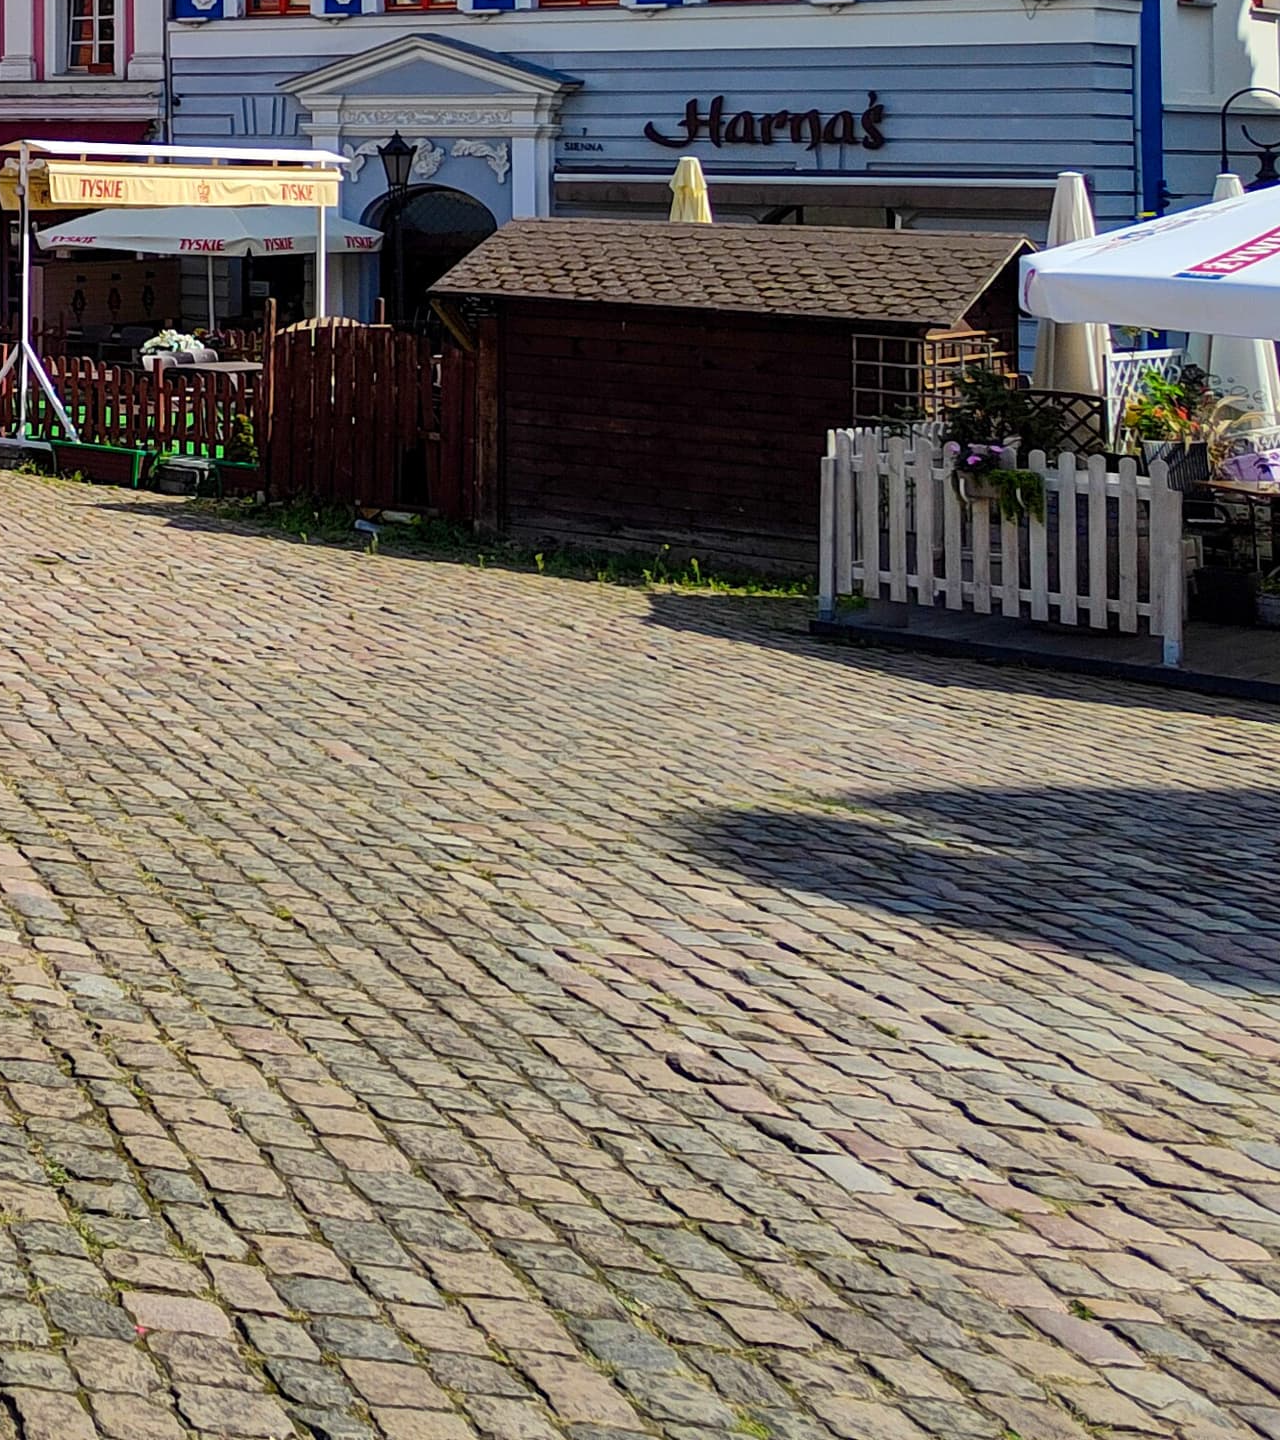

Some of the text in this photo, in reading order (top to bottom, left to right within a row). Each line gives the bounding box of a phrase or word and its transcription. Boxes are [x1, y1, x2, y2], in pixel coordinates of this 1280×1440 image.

[644, 90, 885, 151] Harnaś
[564, 142, 603, 152] SIENNA
[80, 179, 123, 198] TYSKIE
[279, 184, 314, 200] TYSKIE
[179, 239, 225, 251] TYSKIE
[263, 237, 294, 251] TYSKIE
[344, 236, 374, 248] TYSKIE
